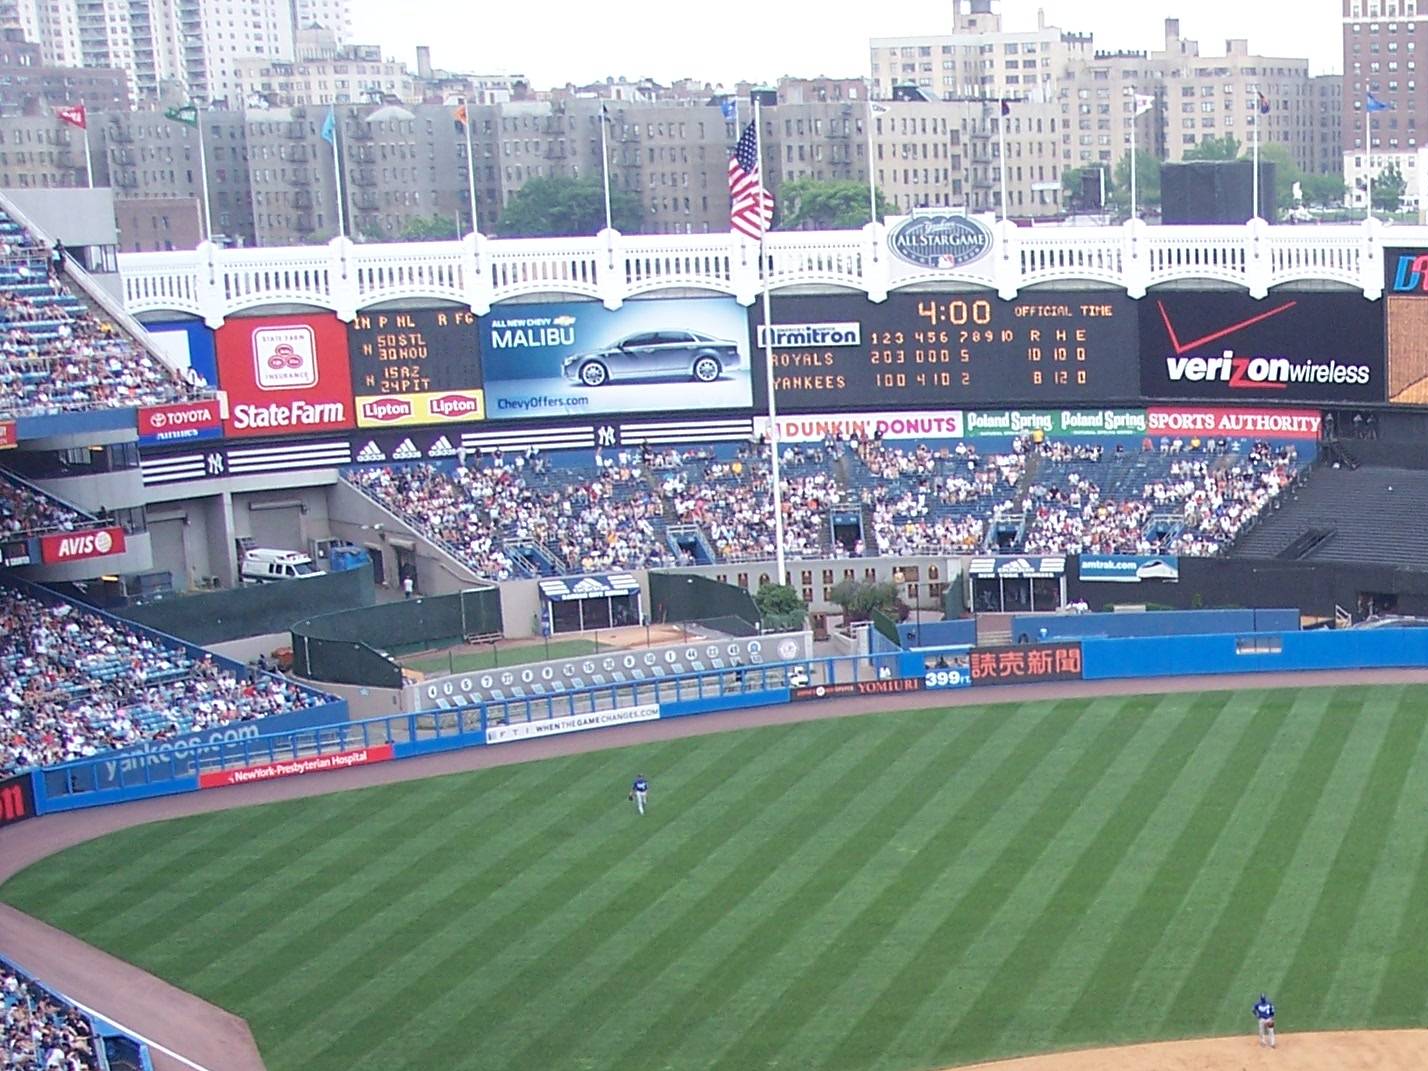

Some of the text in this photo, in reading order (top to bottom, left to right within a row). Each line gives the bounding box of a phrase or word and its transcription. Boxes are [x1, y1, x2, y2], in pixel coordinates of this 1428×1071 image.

[918, 300, 990, 325] 4:00
[1014, 305, 1112, 318] OFFICIAL TIME
[379, 316, 388, 328] P
[437, 313, 448, 326] R
[492, 320, 507, 328] ALL
[491, 327, 575, 349] MALIBU
[761, 326, 857, 345] Armitron
[1030, 329, 1041, 342] R
[1056, 329, 1067, 342] H
[1076, 329, 1086, 342] E
[771, 352, 834, 367] ROYALS
[772, 375, 846, 391] YANKEES
[365, 400, 476, 419] Lipton Lipton
[497, 396, 589, 411] ChevyOffers.com
[166, 409, 212, 425] TOYOTA
[967, 411, 1053, 431] Poland Spring
[1061, 411, 1146, 431] Poland Spring
[1148, 413, 1322, 433] SPORTS AUTHORITY
[785, 417, 956, 437] DUNKIN' DONUTS
[58, 535, 94, 557] AVIS
[1082, 559, 1138, 571] amtrak.com
[971, 647, 1081, 679] 読売新聞
[858, 678, 920, 695] YOMIURI
[924, 671, 961, 687] 399
[331, 750, 368, 768] Hospital
